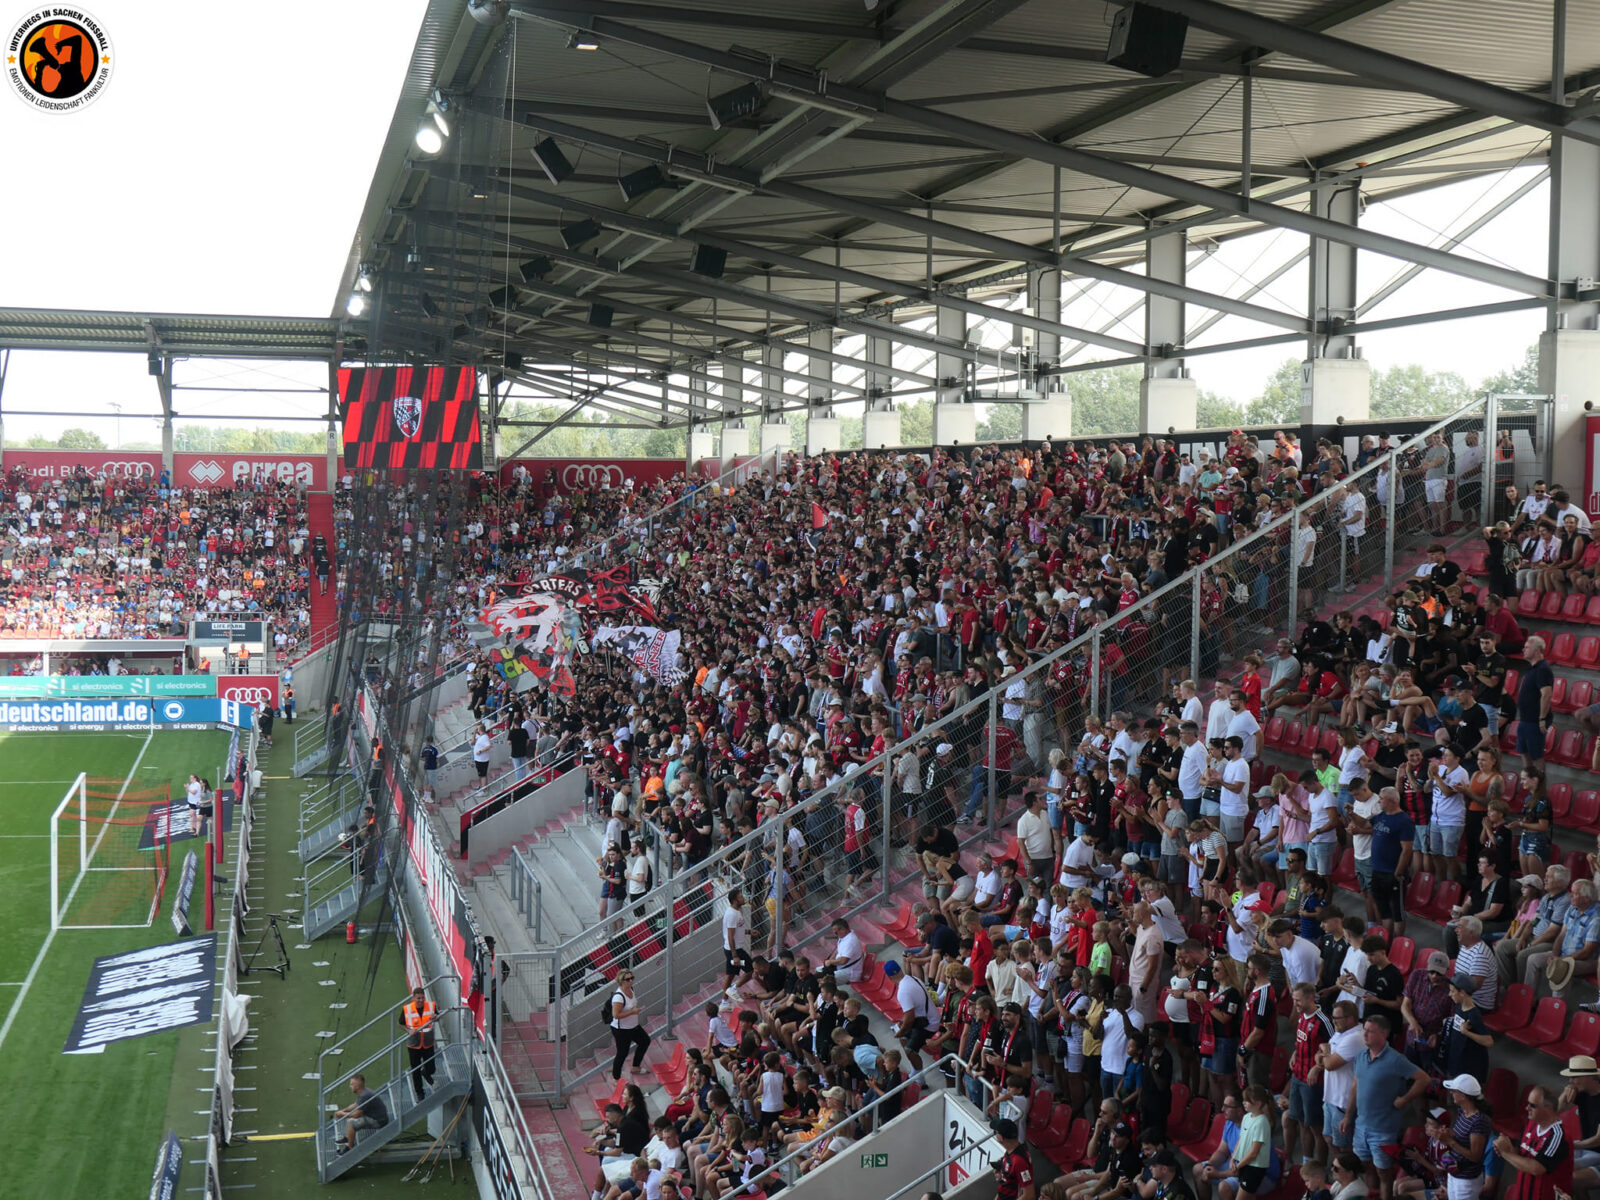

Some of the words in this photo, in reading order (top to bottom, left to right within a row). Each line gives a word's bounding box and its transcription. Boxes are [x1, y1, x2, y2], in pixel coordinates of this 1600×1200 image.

[165, 681, 207, 689] electronics
[78, 724, 104, 732] energy
[181, 723, 207, 731] energy
